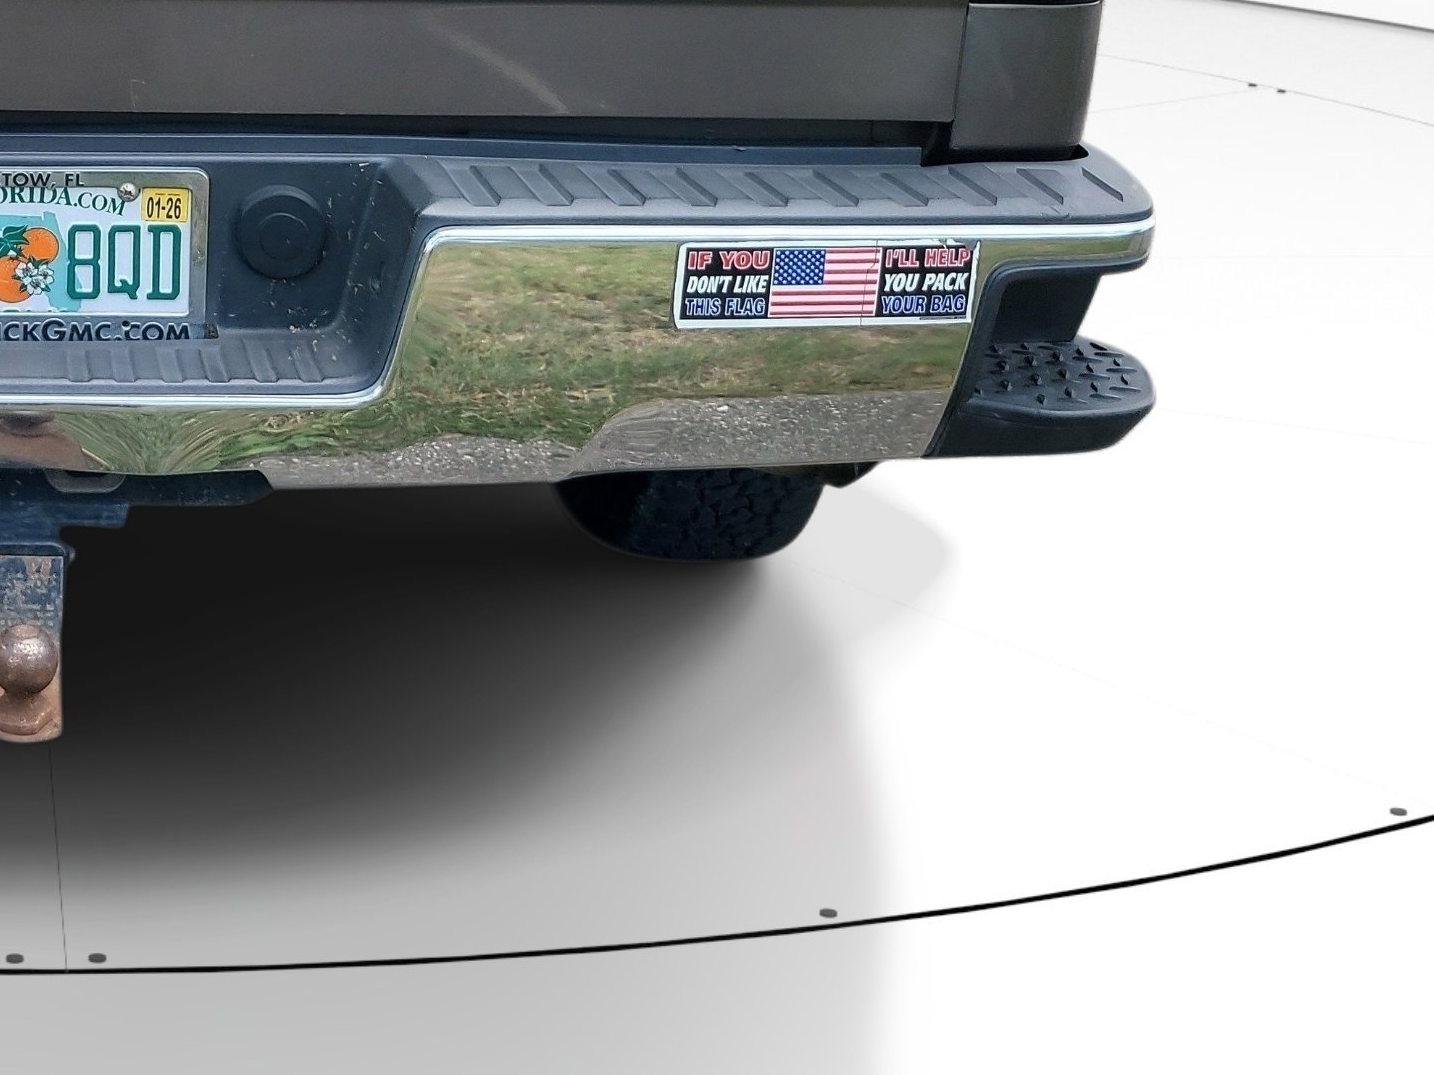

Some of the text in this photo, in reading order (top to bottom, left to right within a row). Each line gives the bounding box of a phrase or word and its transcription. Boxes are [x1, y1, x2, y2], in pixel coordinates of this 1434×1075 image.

[65, 172, 85, 187] FL
[147, 196, 182, 220] 01-26
[66, 224, 183, 301] 8QD
[687, 250, 771, 270] IF YOU
[884, 247, 971, 268] I'LL HELP
[686, 274, 769, 294] DON'T LIKE
[883, 271, 969, 292] YOU PACK
[684, 297, 766, 316] THIS FLAG
[881, 294, 966, 314] YOUR BAG
